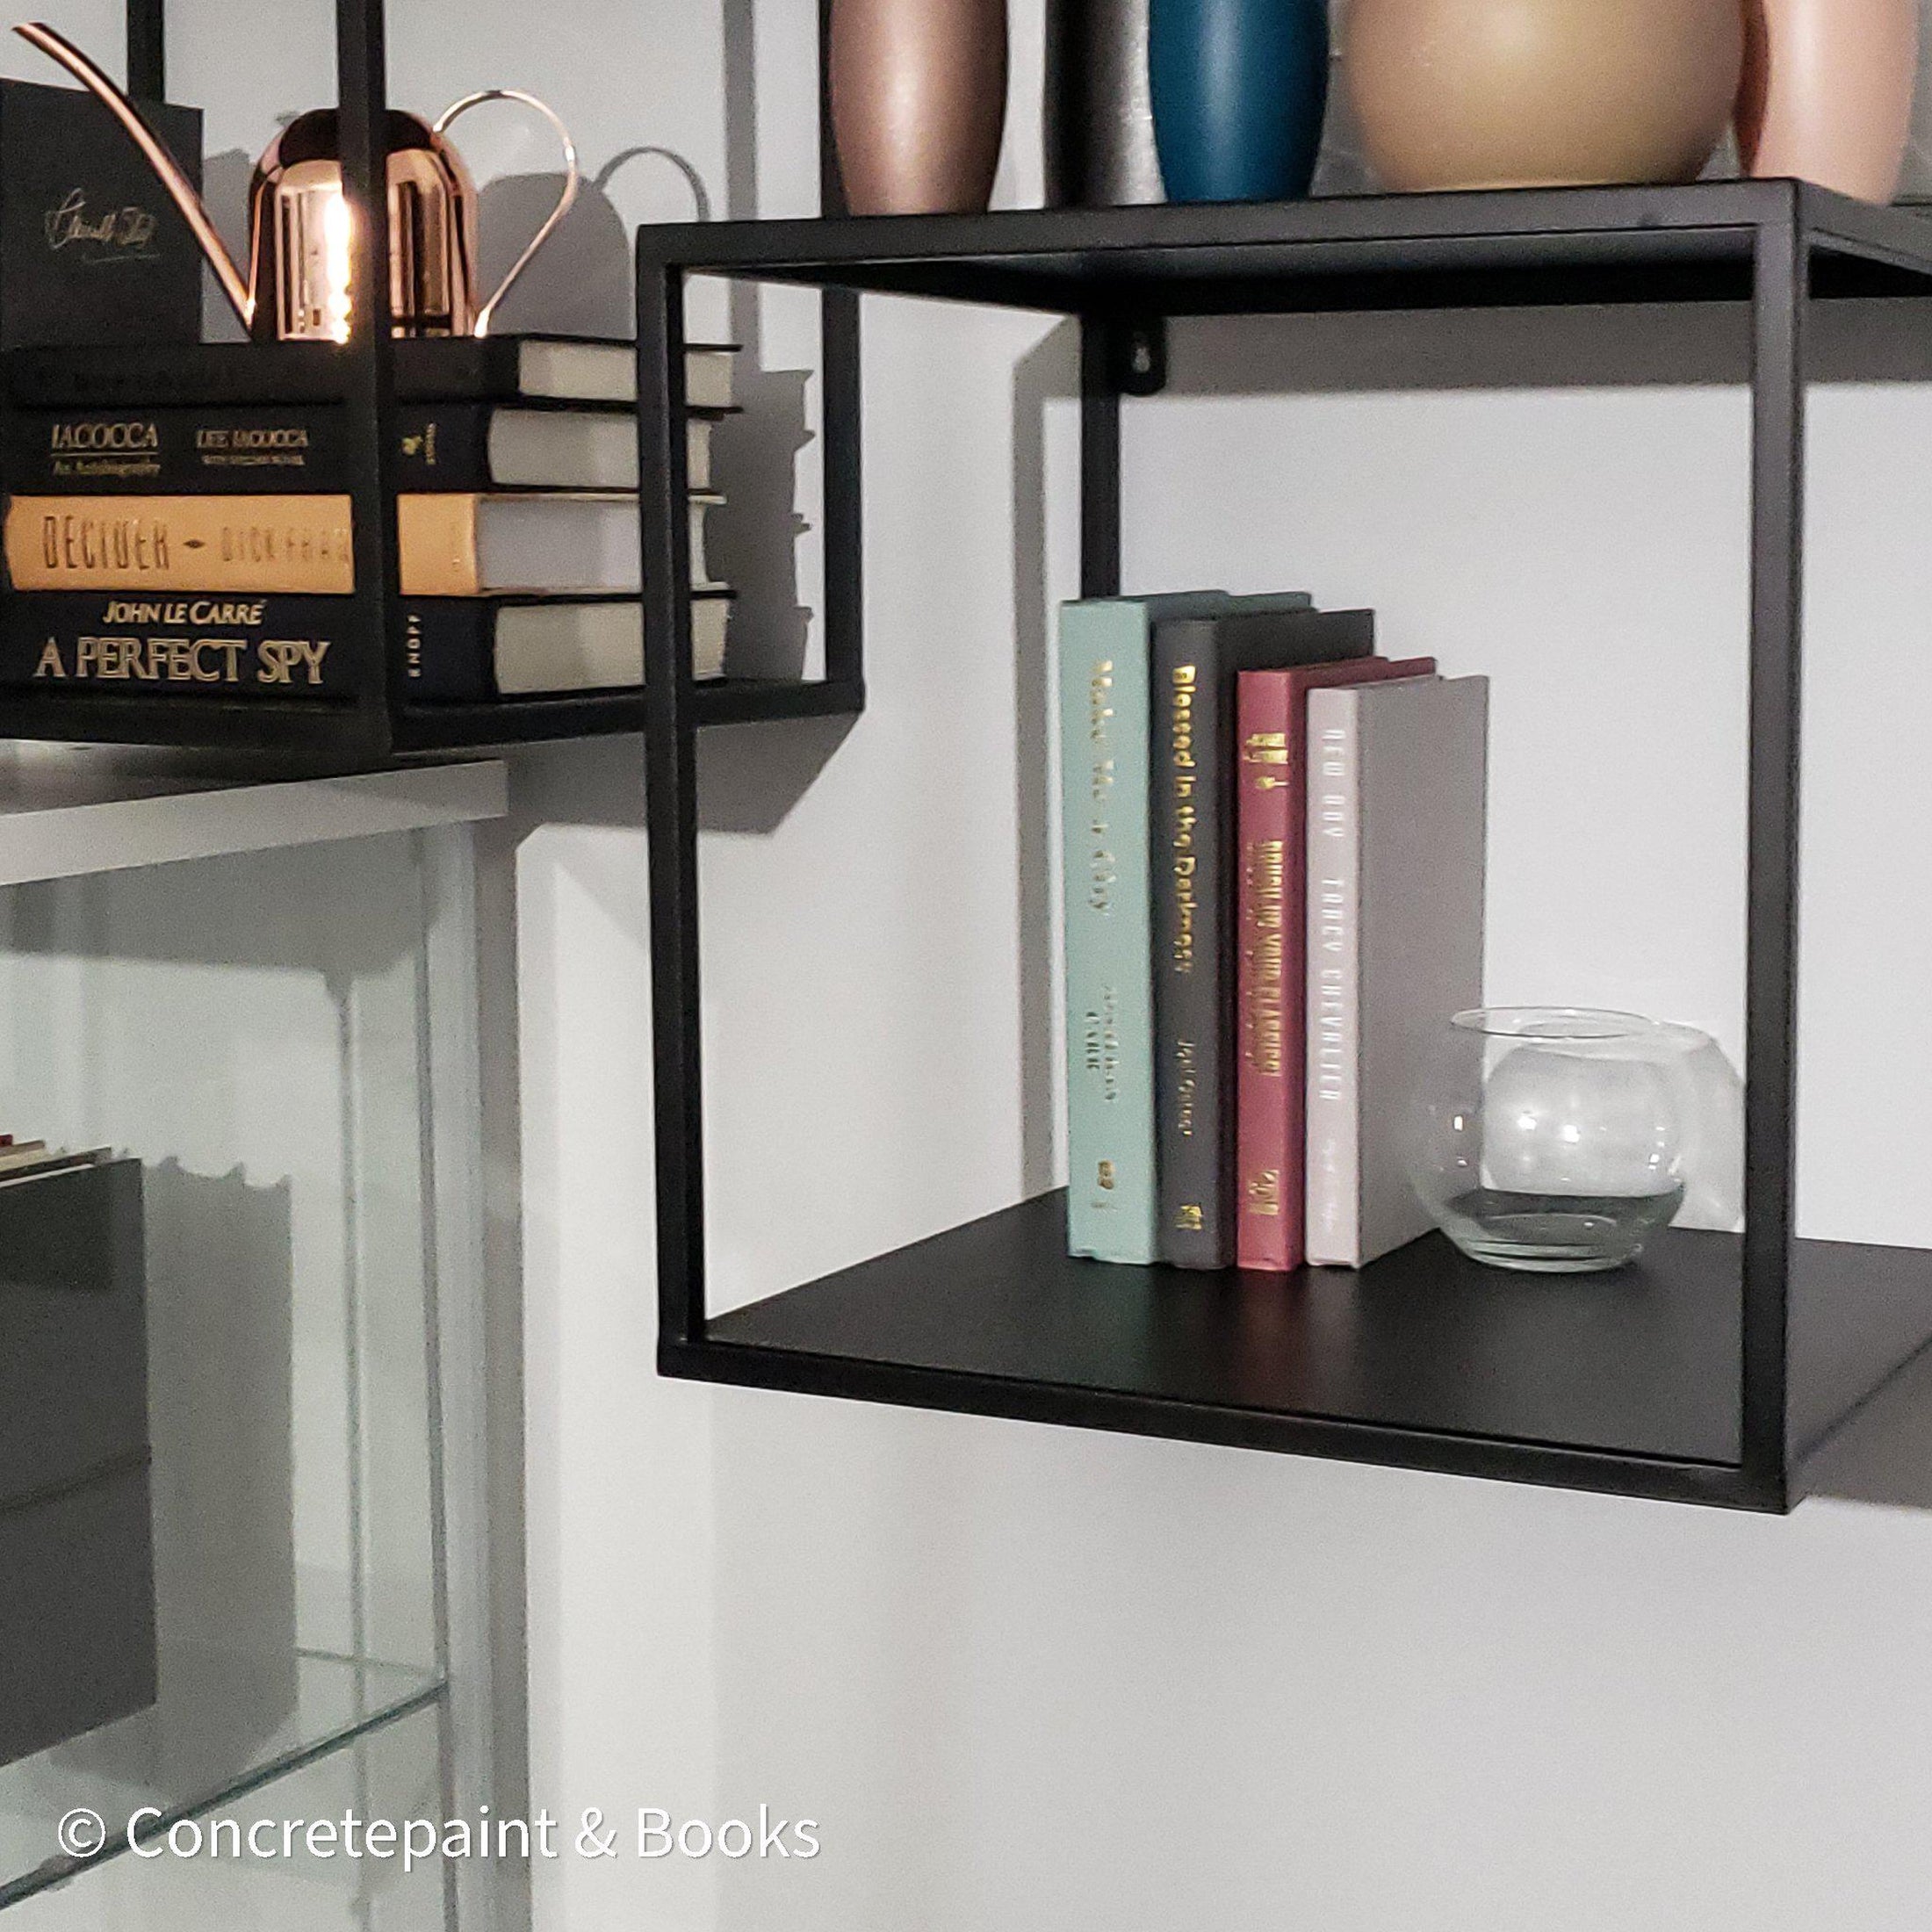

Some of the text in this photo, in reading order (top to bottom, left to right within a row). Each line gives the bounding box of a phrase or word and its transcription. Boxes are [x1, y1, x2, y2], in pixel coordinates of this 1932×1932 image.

[102, 599, 267, 626] JOHN LE CARRÉ
[32, 636, 333, 685] A PERFECT SPY
[1172, 664, 1197, 768] Blessed
[1322, 728, 1346, 778] NEW
[1173, 804, 1197, 847] the
[1173, 855, 1198, 974] Darkness
